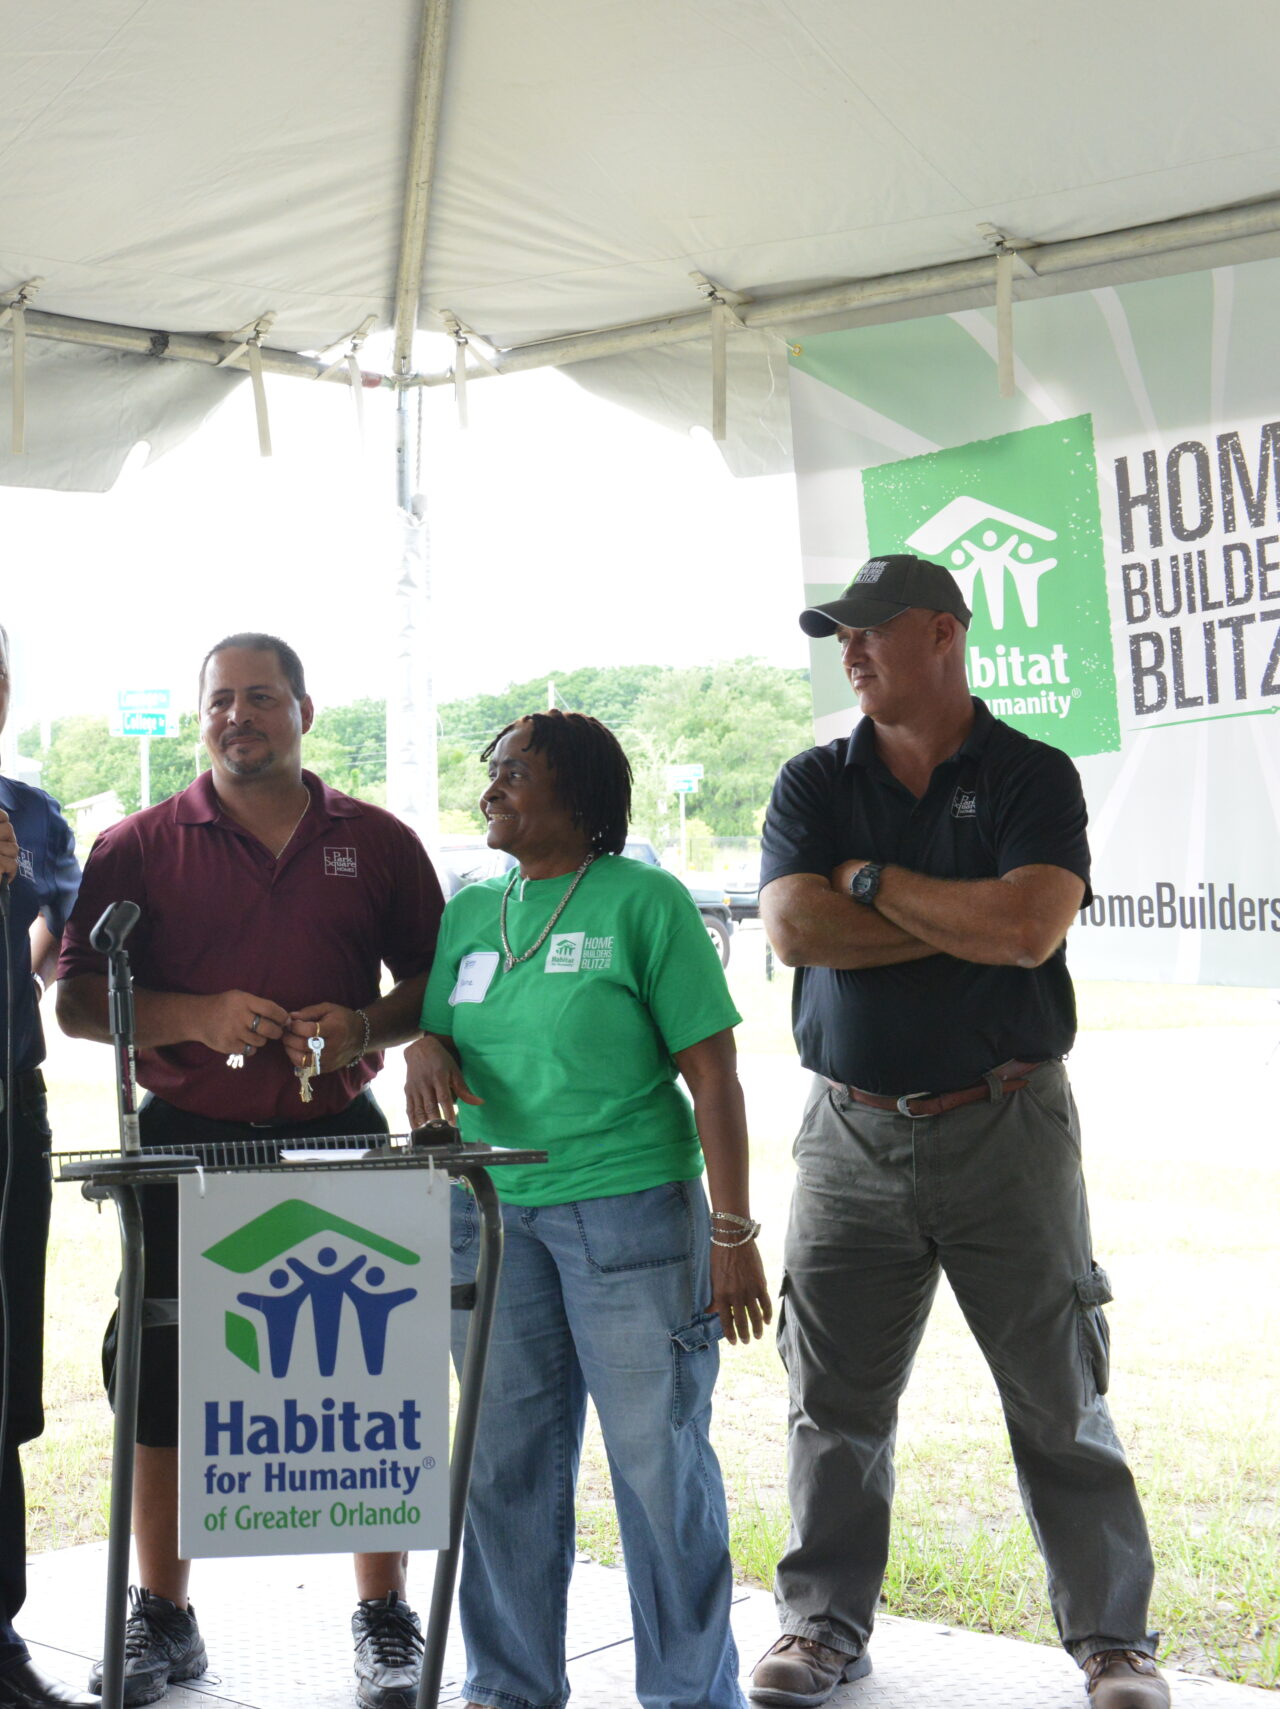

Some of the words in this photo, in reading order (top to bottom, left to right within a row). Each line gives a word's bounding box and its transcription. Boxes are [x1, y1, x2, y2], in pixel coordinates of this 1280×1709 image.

[1122, 535, 1280, 625] BUILDE
[965, 644, 1070, 688] bitat
[324, 856, 356, 868] Square
[333, 851, 353, 863] Park
[584, 936, 614, 950] HOME
[581, 958, 605, 969] BLITZ
[204, 1397, 422, 1456] Habitat
[204, 1463, 251, 1495] for
[204, 1505, 228, 1532] of
[235, 1504, 322, 1530] Greater
[329, 1500, 421, 1527] Orlando
